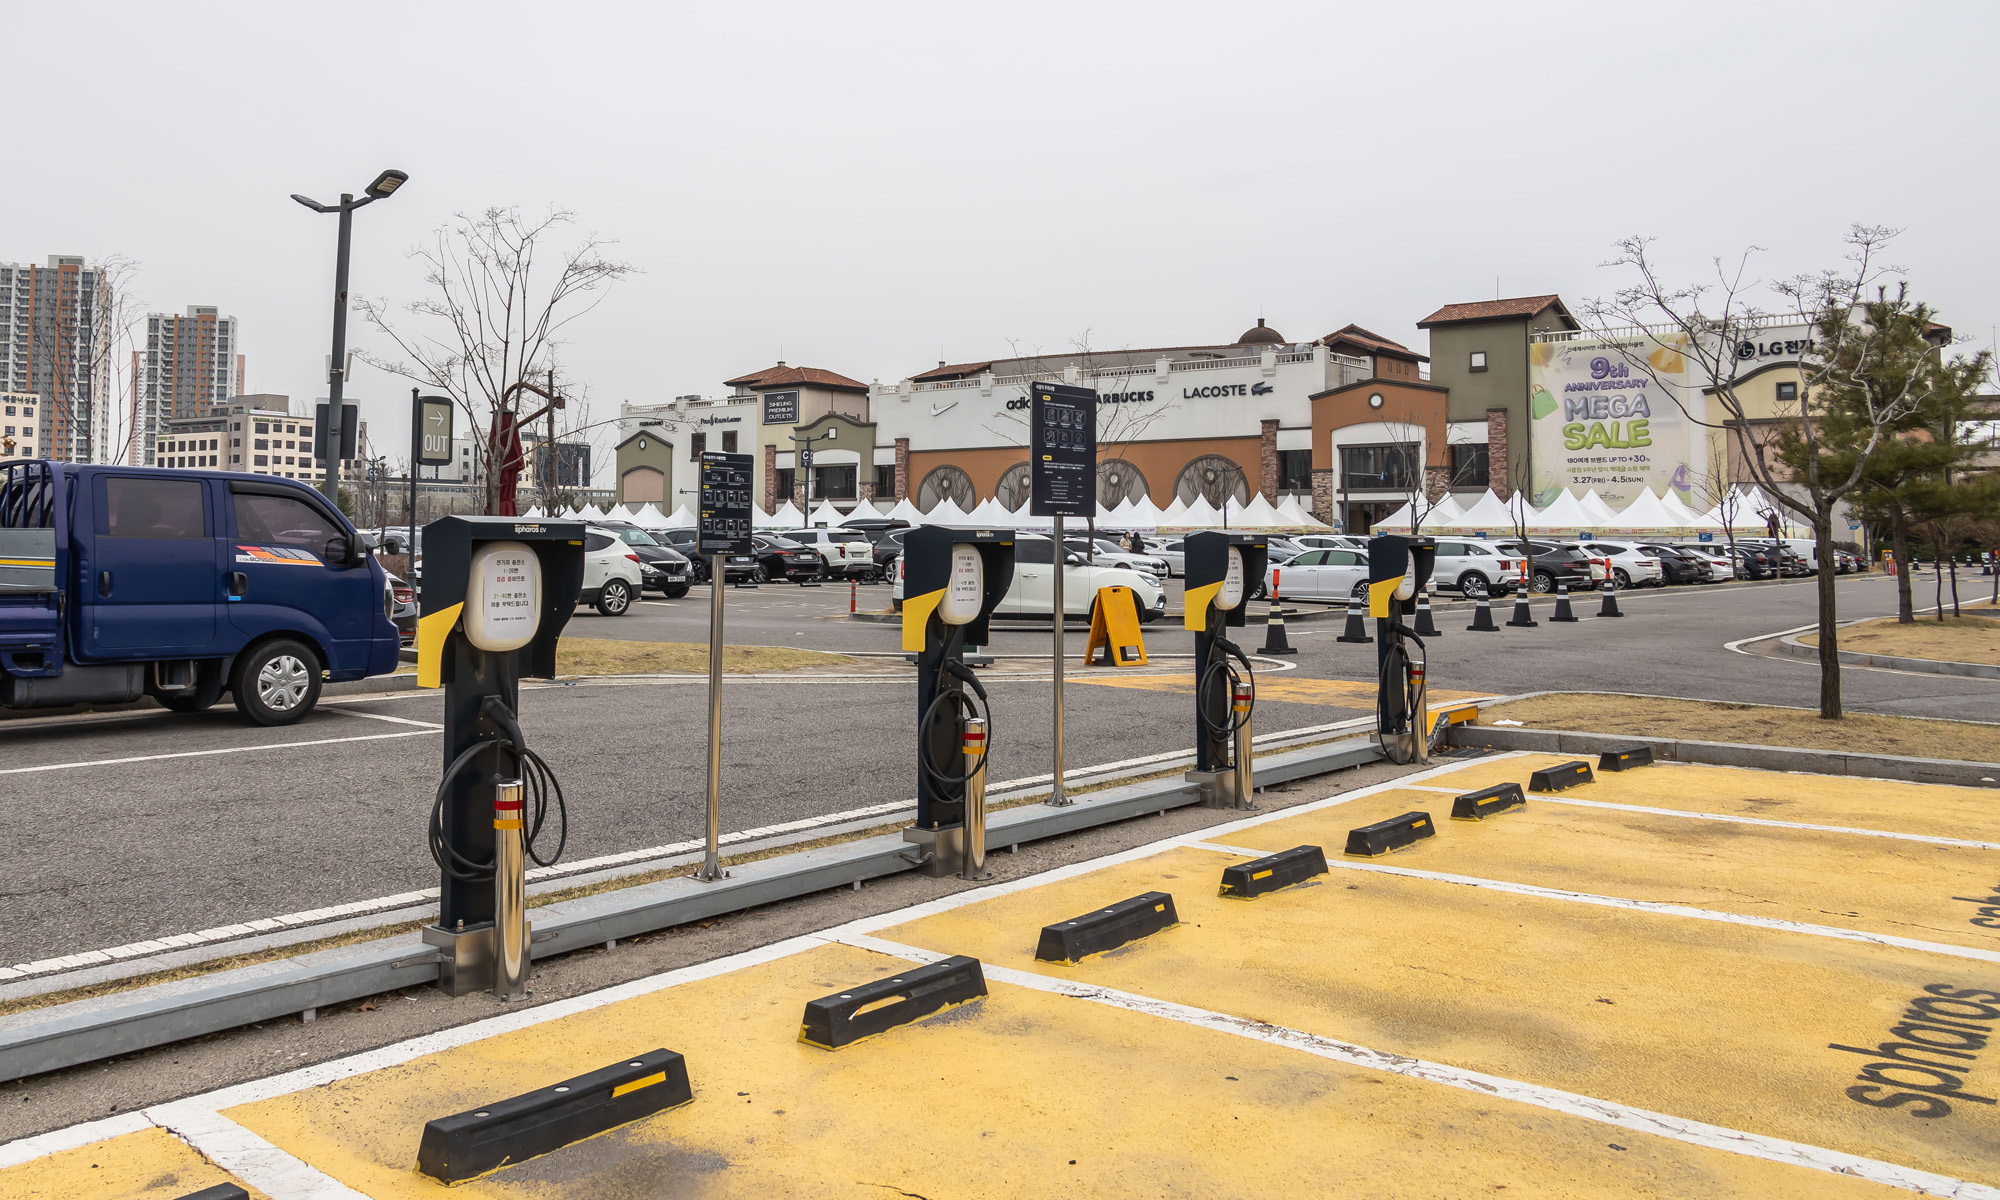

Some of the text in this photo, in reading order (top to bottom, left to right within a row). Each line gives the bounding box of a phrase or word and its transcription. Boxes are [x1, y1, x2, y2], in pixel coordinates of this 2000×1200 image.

[1590, 356, 1629, 379] 9th
[1183, 384, 1247, 399] LACOSTE
[1564, 378, 1649, 393] ANNIVERSARY
[1564, 393, 1651, 422] MEGA
[1562, 418, 1652, 450] SALE
[424, 434, 448, 452] OUT
[802, 451, 809, 460] C
[1573, 476, 1606, 484] 3.27(FRI)
[1611, 475, 1644, 483] 4.5(SUN)
[514, 525, 539, 534] spharos
[1828, 983, 2000, 1118] spharos
